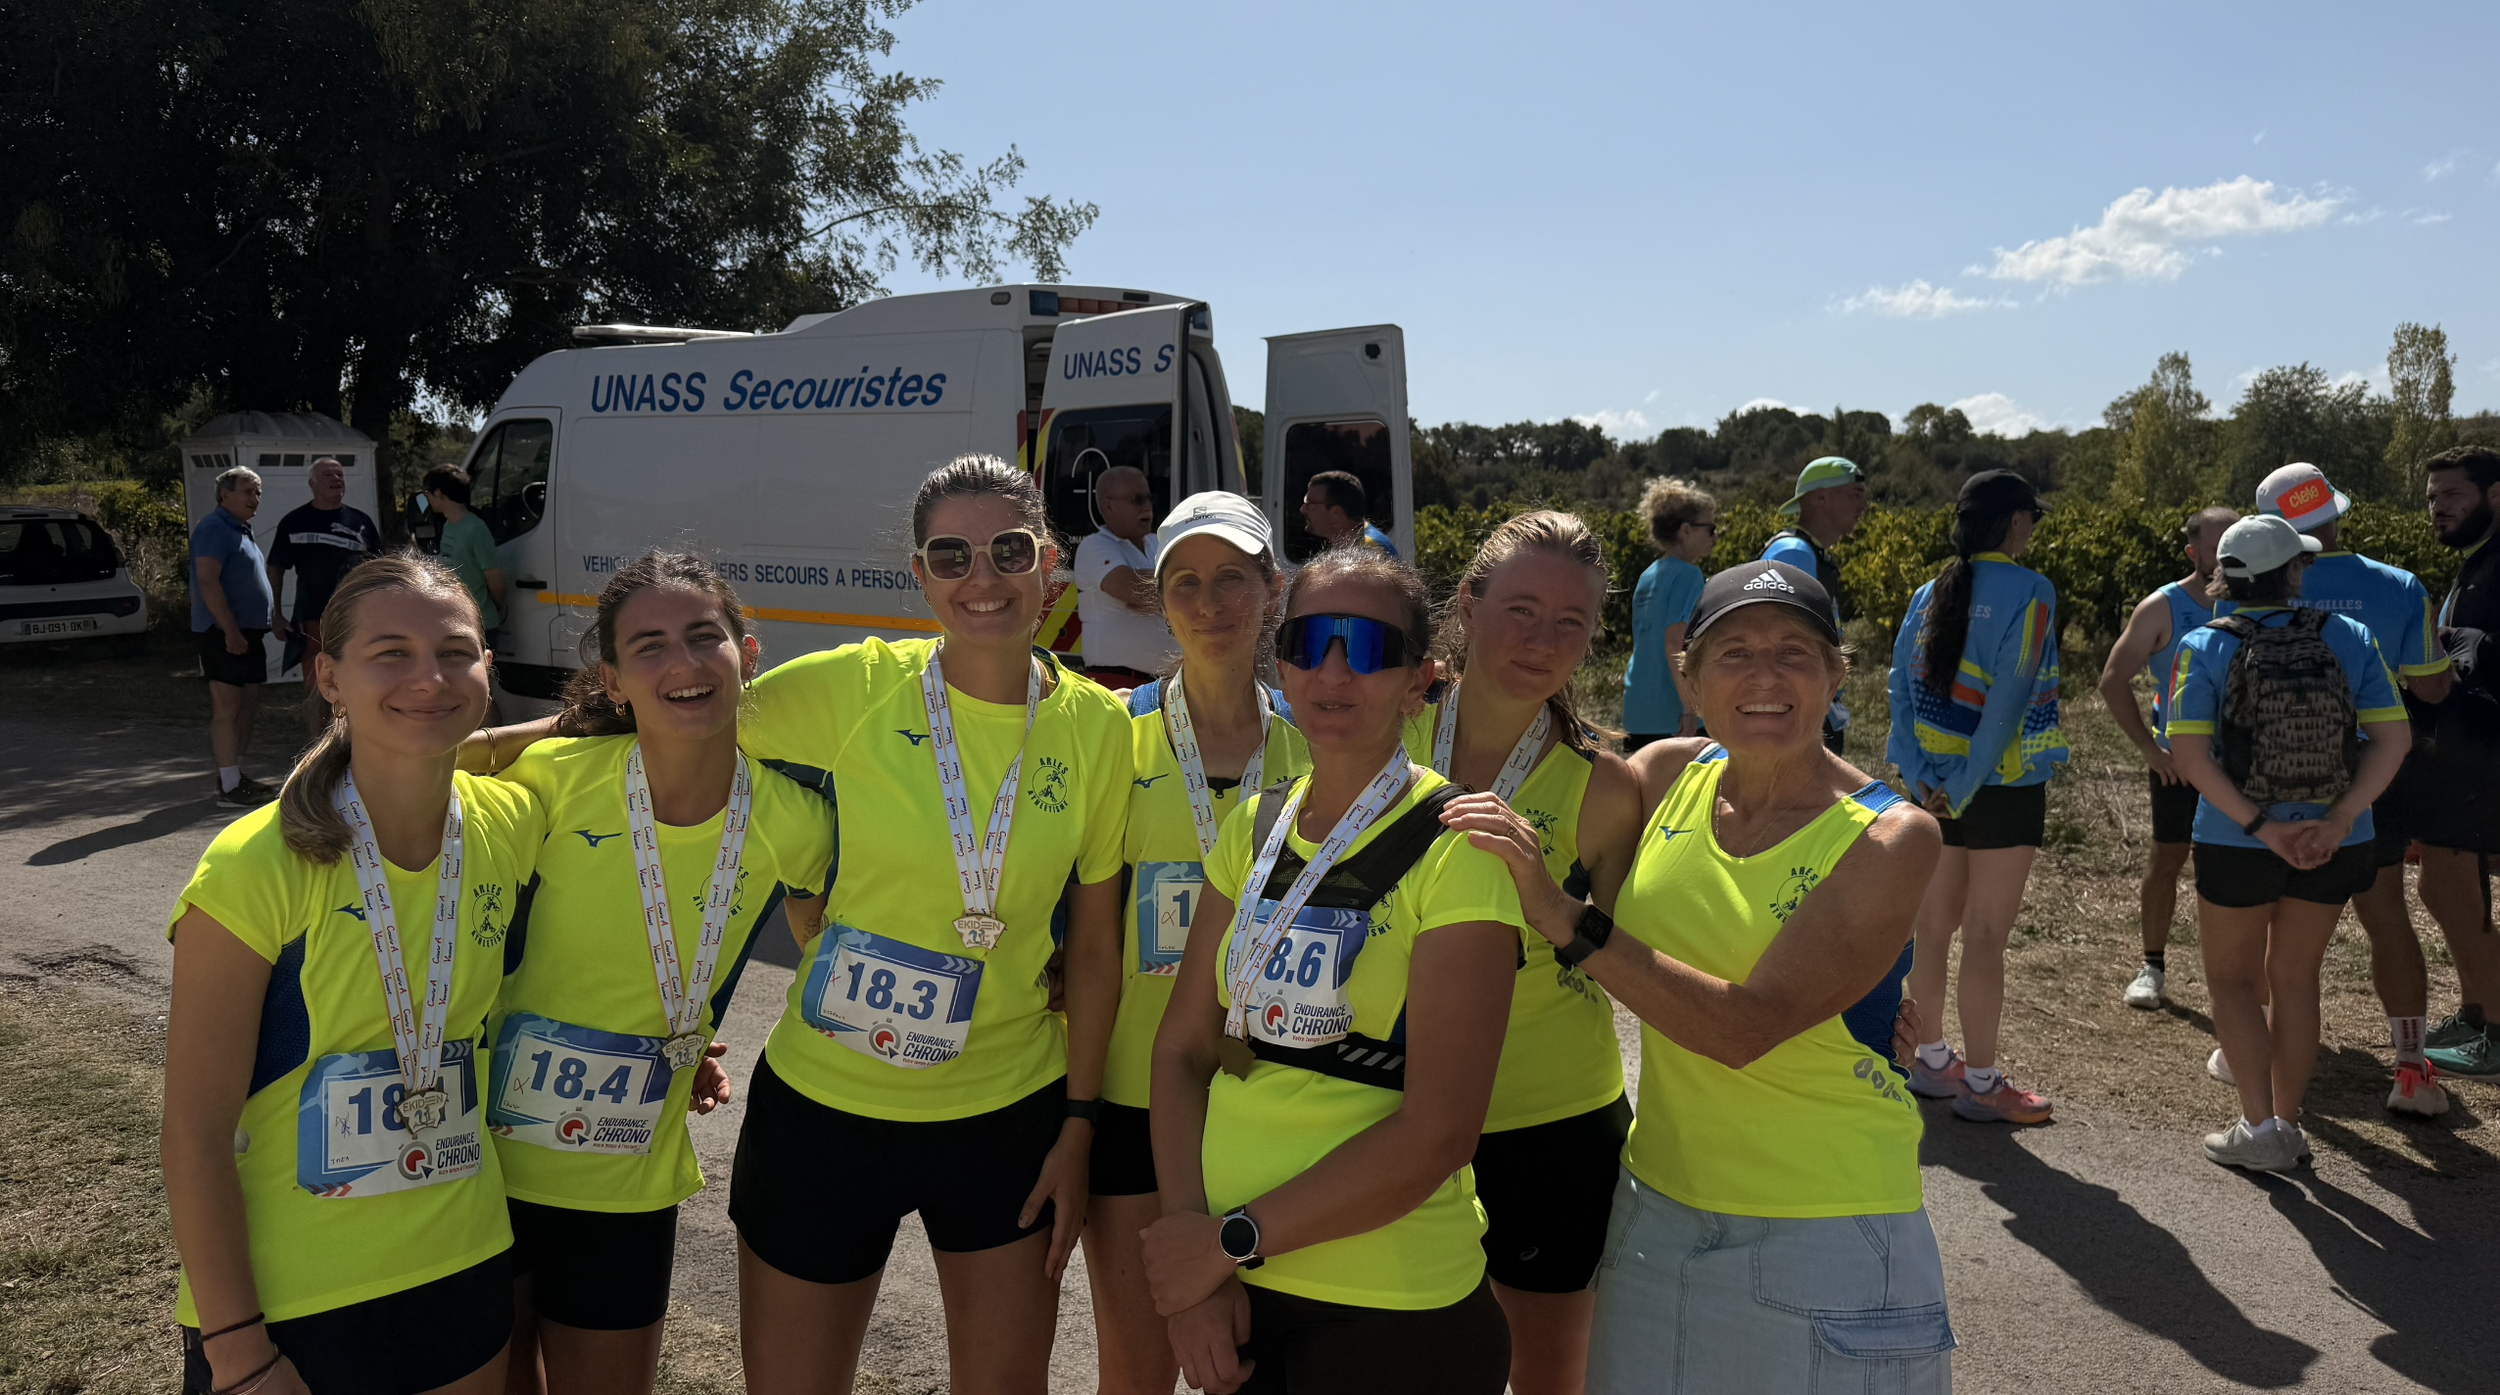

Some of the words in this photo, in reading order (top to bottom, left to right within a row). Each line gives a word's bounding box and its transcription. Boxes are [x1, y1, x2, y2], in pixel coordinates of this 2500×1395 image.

[1064, 347, 1141, 380] UNASS
[1154, 344, 1175, 373] S
[591, 372, 706, 412] UNASS
[723, 366, 947, 411] Secouristes
[755, 564, 829, 586] SECOURS
[835, 568, 846, 586] A
[1743, 580, 1795, 594] adidas
[2315, 599, 2363, 610] GILLES
[1040, 757, 1069, 775] ARLES
[473, 883, 503, 898] ARLES
[957, 920, 1001, 930] EKIDEN
[1254, 937, 1327, 988] 8.6
[846, 961, 939, 1021] 18.3
[1294, 1002, 1346, 1018] ENDURANCE
[1292, 1014, 1353, 1036] CHRONO
[906, 1031, 956, 1050] ENDURANCE
[530, 1049, 632, 1104] 18.4
[597, 1116, 649, 1128] ENDURANCE
[436, 1131, 475, 1150] ENDURANCE
[593, 1127, 652, 1144] CHRONO
[437, 1142, 480, 1169] CHRONO
